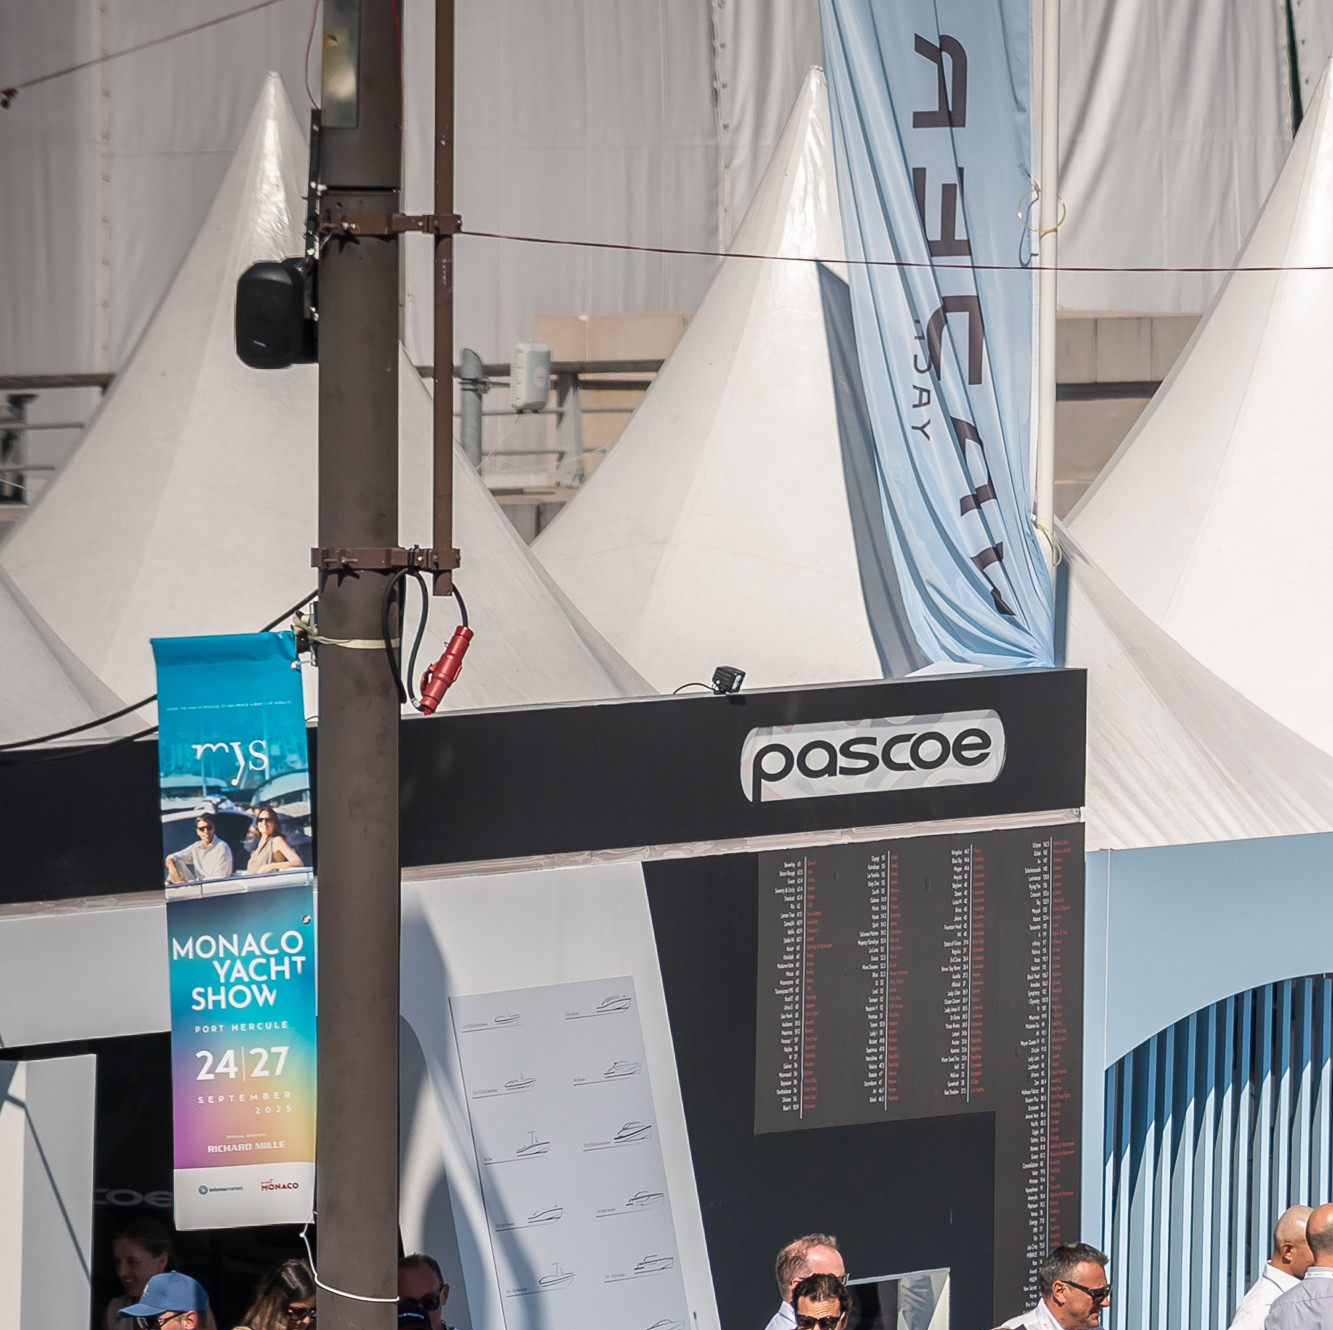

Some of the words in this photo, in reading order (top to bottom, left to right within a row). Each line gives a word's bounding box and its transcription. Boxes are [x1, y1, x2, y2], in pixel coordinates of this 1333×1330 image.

[752, 728, 992, 802] pascoe
[172, 930, 304, 961] MONACO
[212, 955, 307, 984] YACHT
[191, 983, 277, 1011] SHOW
[194, 1024, 225, 1034] PORT
[231, 1020, 289, 1032] HERCULE
[197, 1090, 292, 1104] SEPTEMBER
[255, 1104, 292, 1115] 2025
